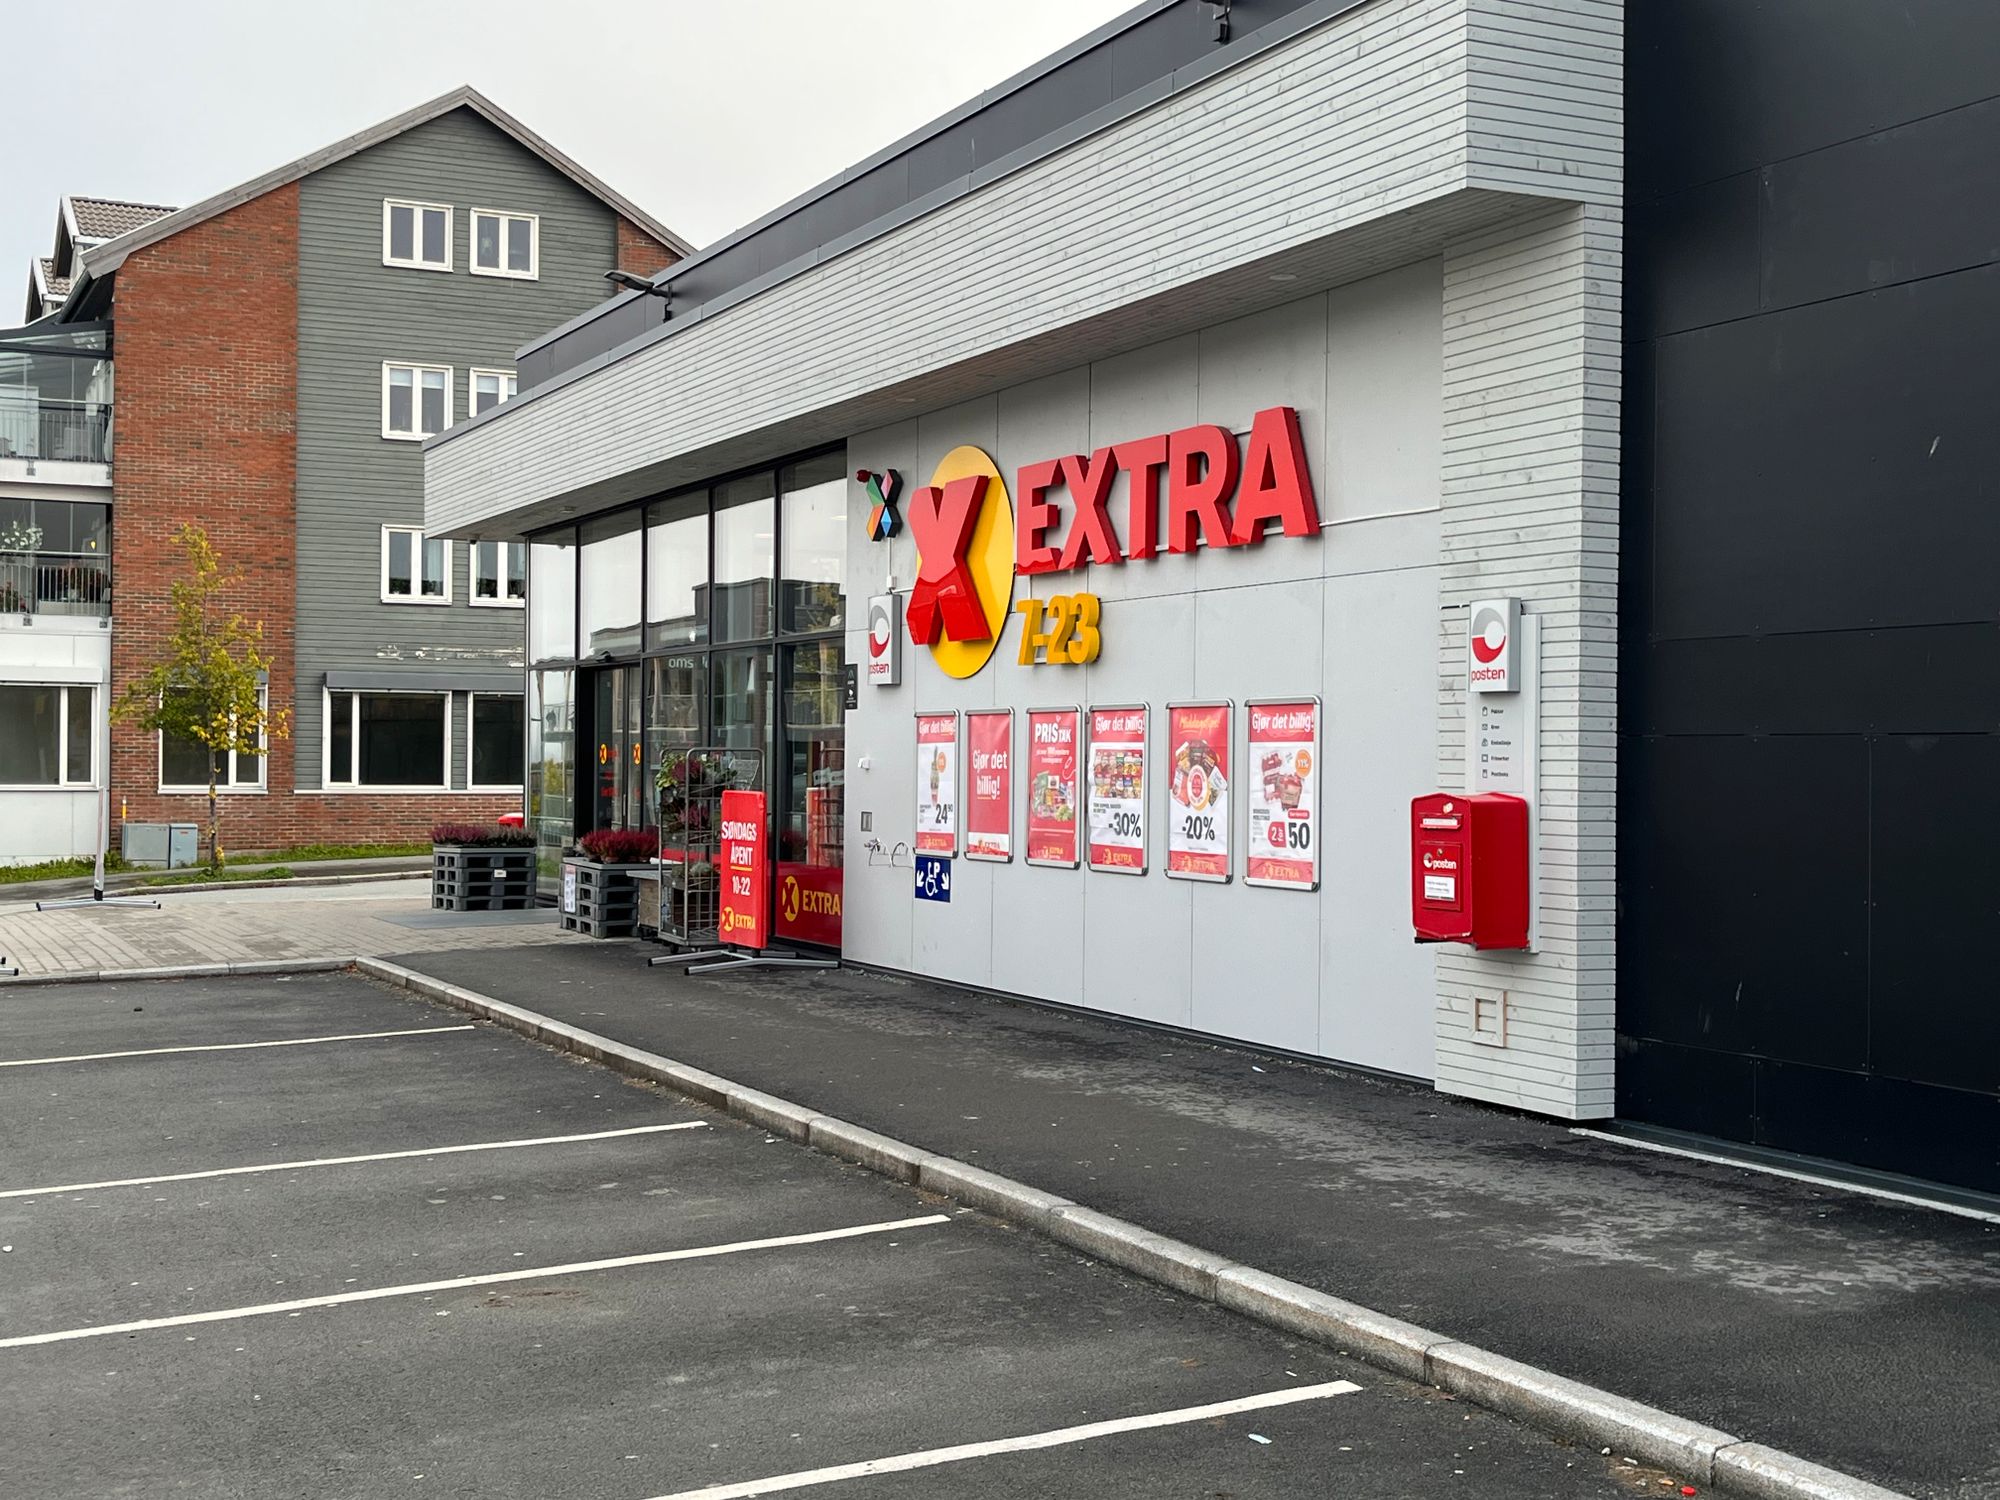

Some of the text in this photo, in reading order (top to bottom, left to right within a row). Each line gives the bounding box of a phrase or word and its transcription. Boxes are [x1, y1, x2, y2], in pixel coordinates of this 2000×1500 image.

[1016, 406, 1320, 576] EXTRA
[1017, 592, 1100, 665] 7-23
[1471, 667, 1505, 683] posten
[930, 720, 940, 734] det
[1095, 713, 1145, 735] Gjør det billig!
[1252, 711, 1314, 733] Gjør det billig!
[972, 750, 1007, 773] Gjør det
[976, 775, 1000, 800] billig!
[935, 803, 948, 825] 24
[1108, 812, 1142, 838] -30%
[721, 820, 758, 842] SØNDAGS
[1182, 815, 1215, 841] -20%
[1271, 825, 1278, 842] 2
[1288, 822, 1311, 850] 50
[730, 841, 754, 866] ÅPENT
[1432, 859, 1457, 870] posten
[933, 861, 941, 879] P
[732, 875, 752, 896] 10-22
[802, 889, 841, 916] EXTRA
[735, 914, 756, 930] EXTRA
